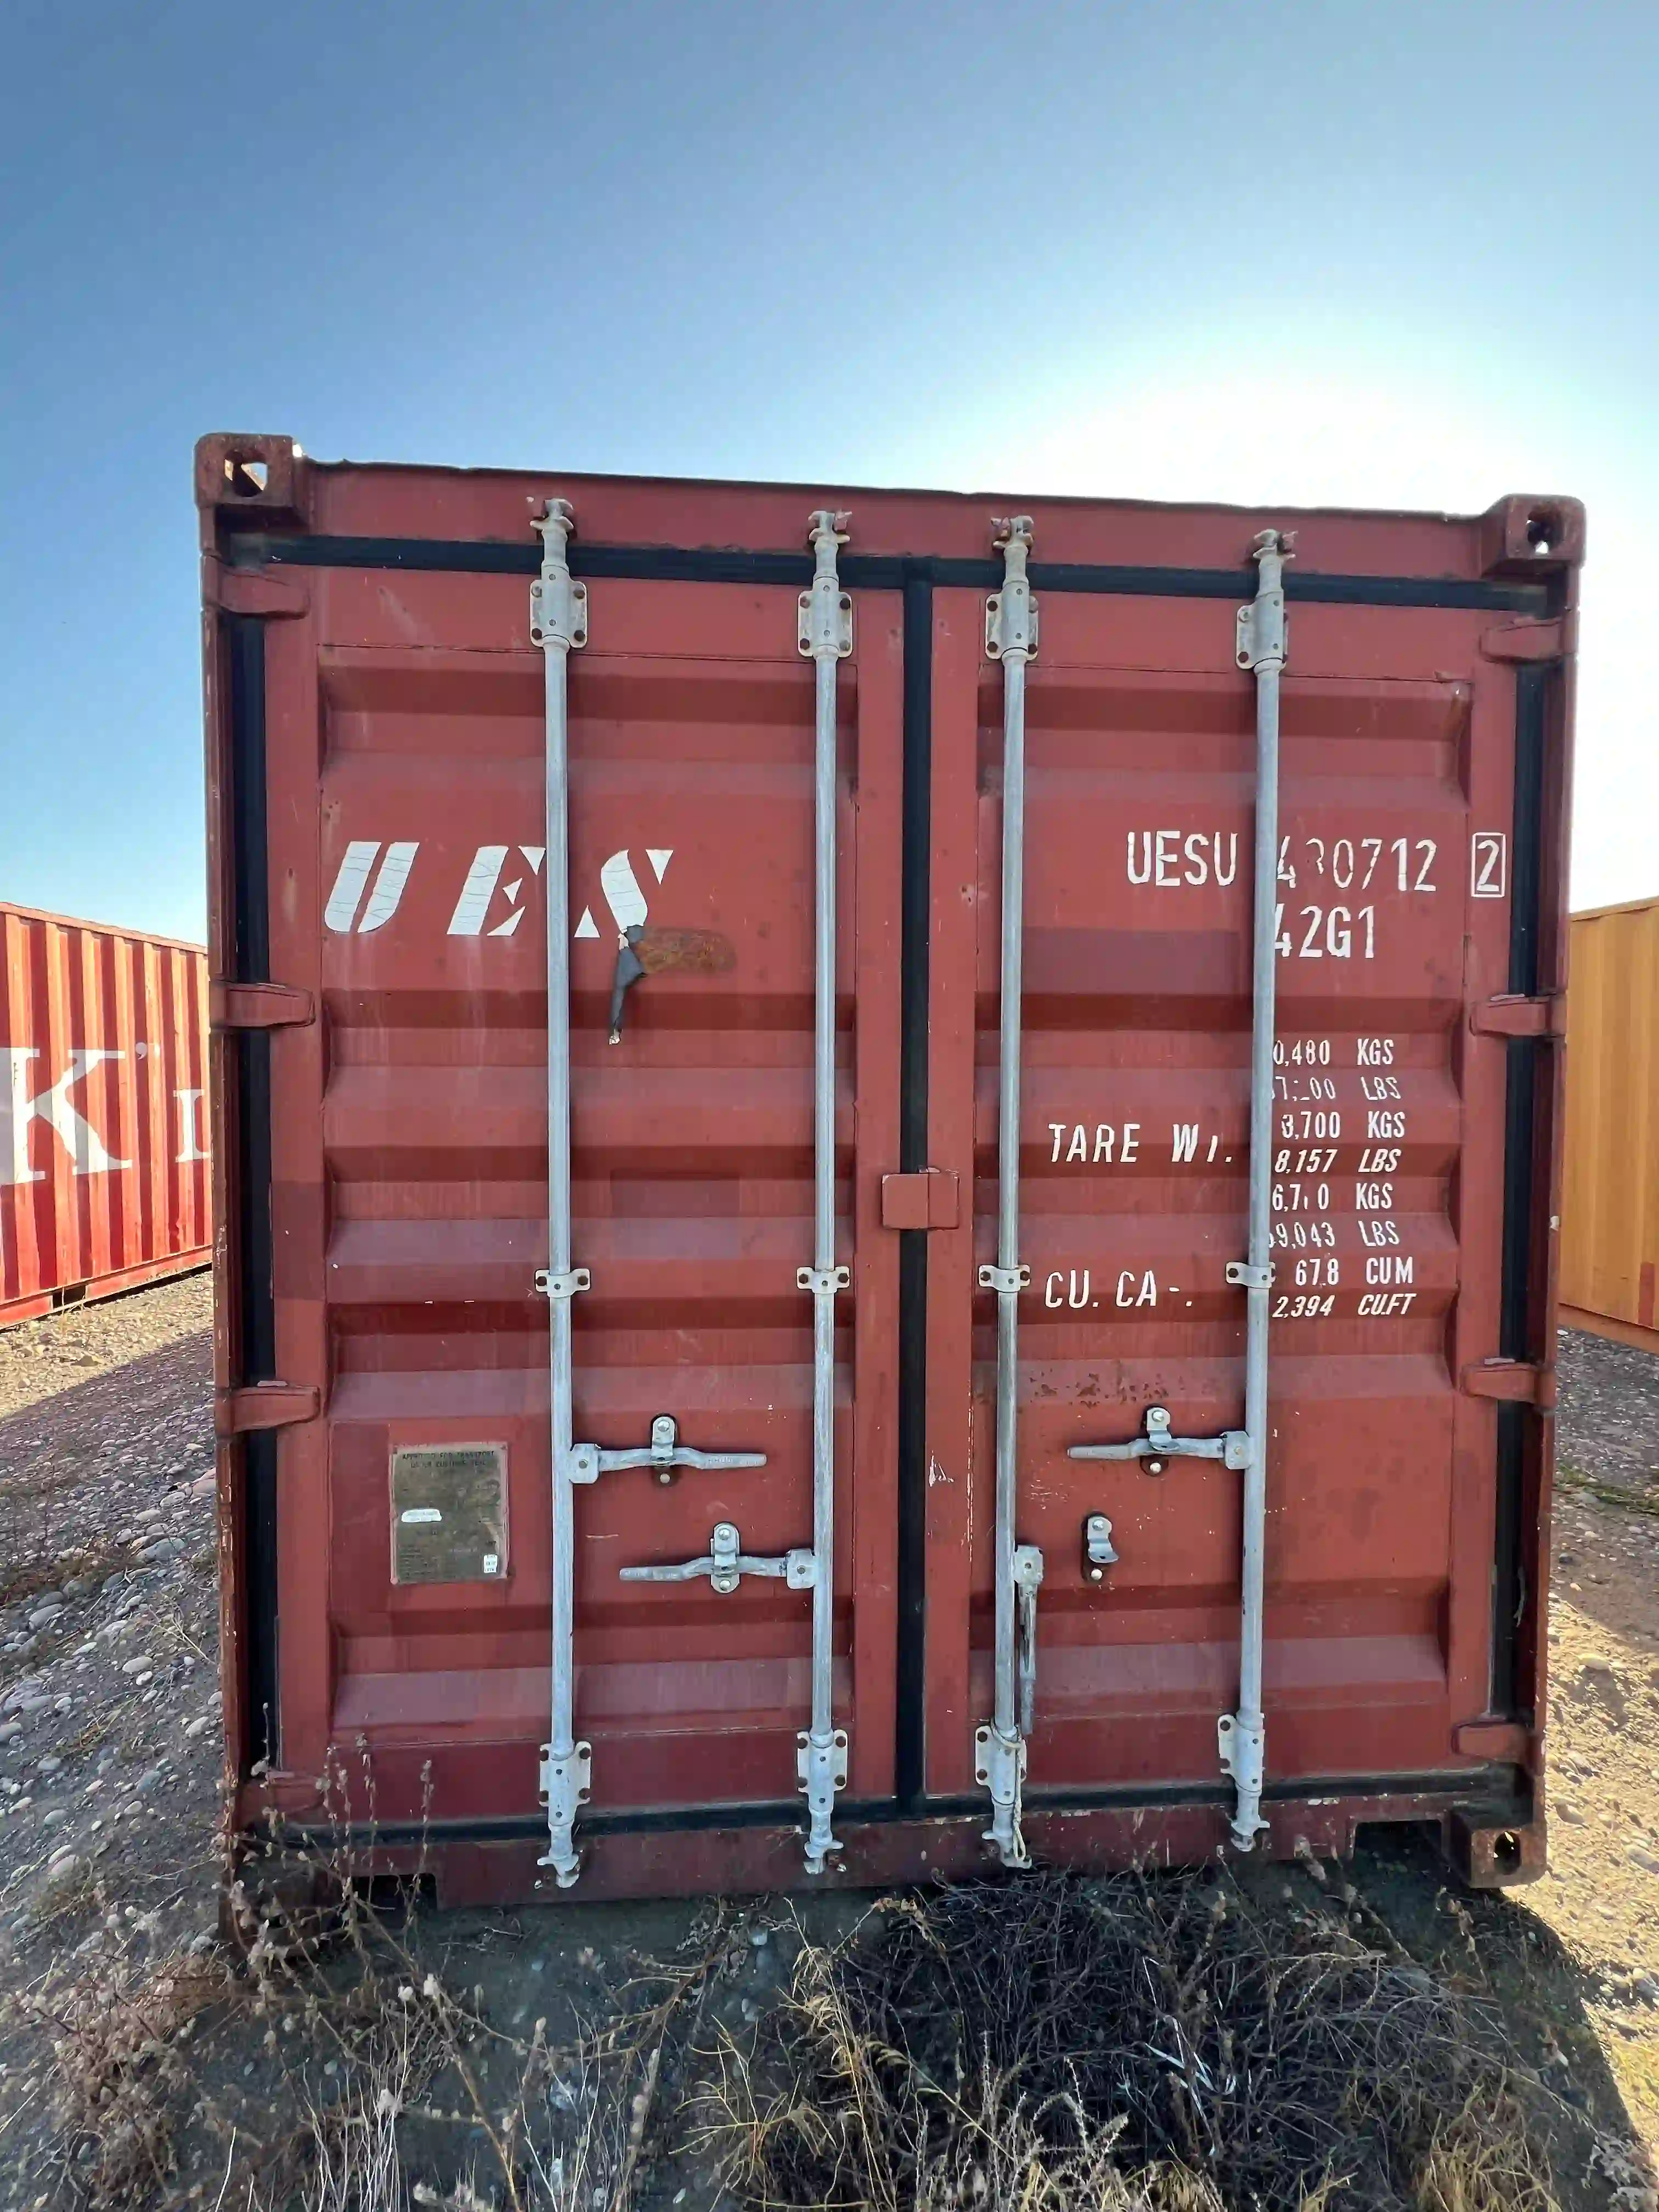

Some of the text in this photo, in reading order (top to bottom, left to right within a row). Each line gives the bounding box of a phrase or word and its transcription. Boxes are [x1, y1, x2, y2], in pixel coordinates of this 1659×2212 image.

[1127, 831, 1238, 886] UESU
[1476, 840, 1499, 892] 2
[1274, 904, 1375, 958] 42G1
[1357, 1038, 1394, 1065] KGS
[1361, 1076, 1402, 1101] LBS
[1368, 1111, 1406, 1139] KGS
[1048, 1124, 1140, 1163] TARE
[1274, 1148, 1402, 1173] 8,157 LBS
[1356, 1182, 1393, 1210] KGS
[1358, 1220, 1400, 1246] LBS
[1365, 1256, 1413, 1285] CUM
